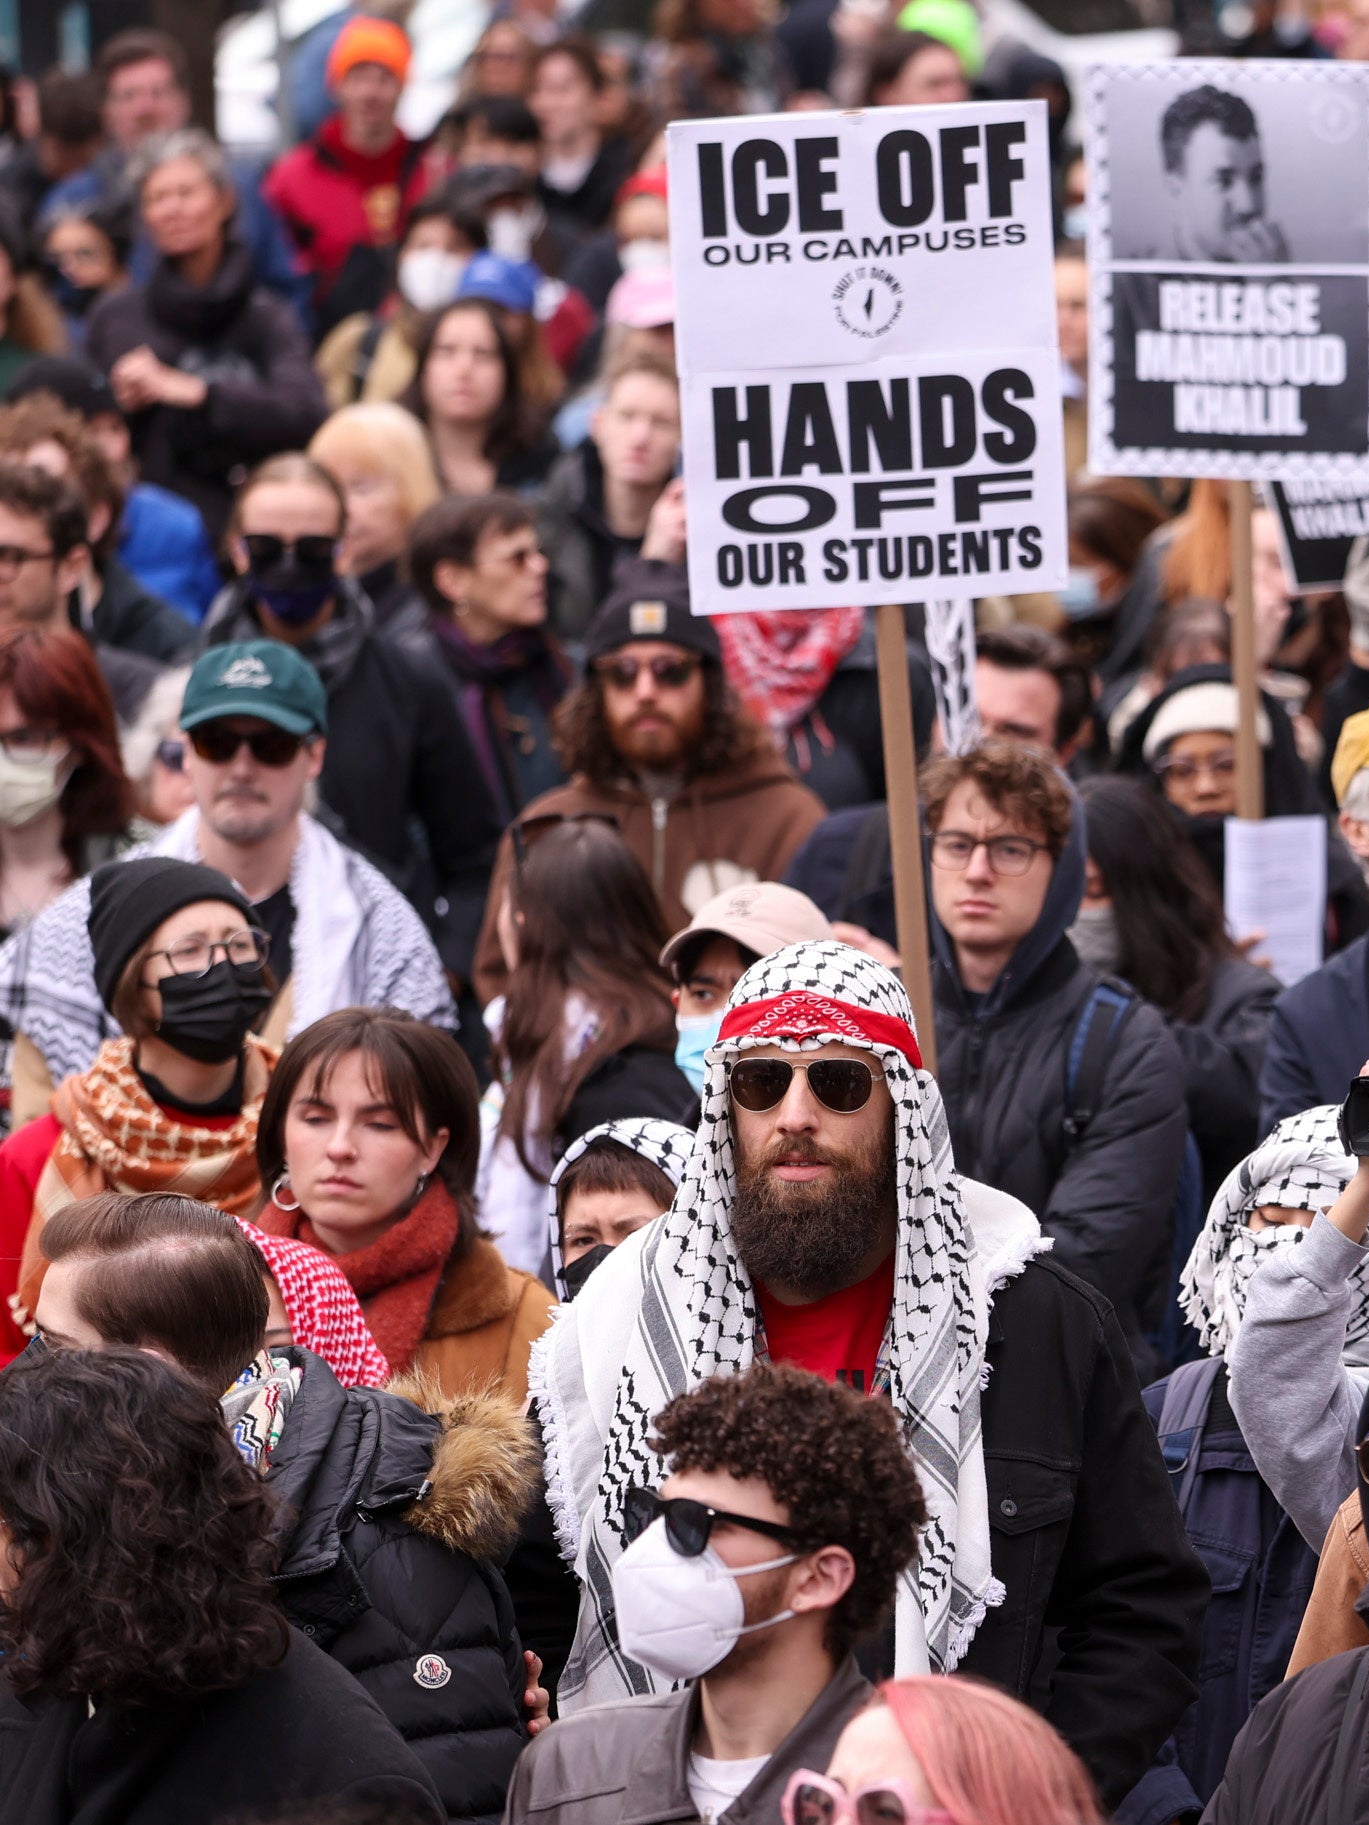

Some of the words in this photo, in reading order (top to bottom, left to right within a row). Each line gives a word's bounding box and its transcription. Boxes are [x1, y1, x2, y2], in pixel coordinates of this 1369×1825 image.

[697, 136, 843, 239] ICE
[876, 121, 1026, 228] OFF
[703, 241, 791, 267] OUR
[803, 224, 1027, 262] CAMPUSES
[832, 273, 854, 300] SHUT
[855, 266, 866, 280] IT
[1160, 281, 1321, 335] RELEASE
[1136, 332, 1347, 387] MAHMOUD
[711, 368, 1036, 480] HANDS
[1174, 384, 1308, 435] KHALIL
[721, 470, 1034, 534] OFF
[717, 541, 805, 588] OUR
[823, 525, 1043, 583] STUDENTS
